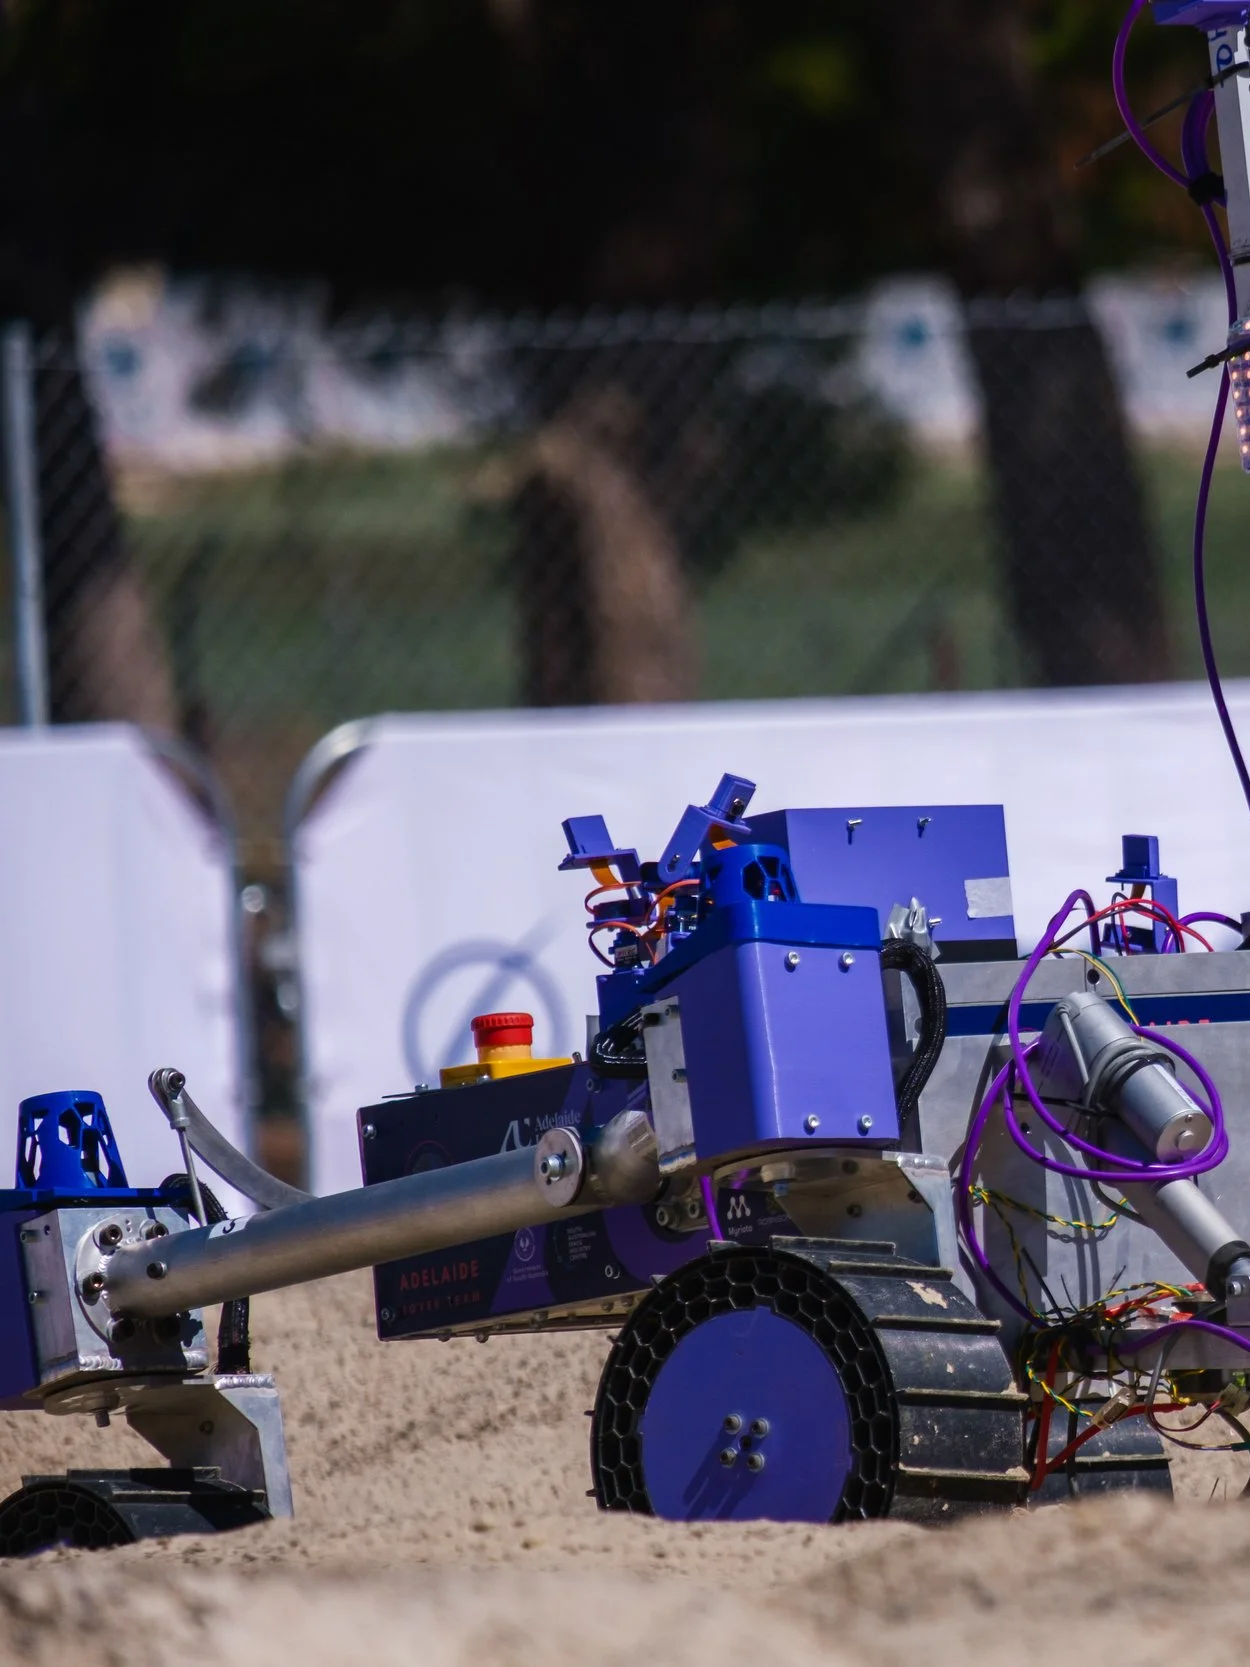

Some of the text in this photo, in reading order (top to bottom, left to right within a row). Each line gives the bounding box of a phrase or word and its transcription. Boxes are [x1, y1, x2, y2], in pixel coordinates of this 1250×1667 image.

[535, 1109, 581, 1132] Adelaide
[728, 1224, 753, 1238] Myriota
[400, 1259, 480, 1292] ADELAIDE
